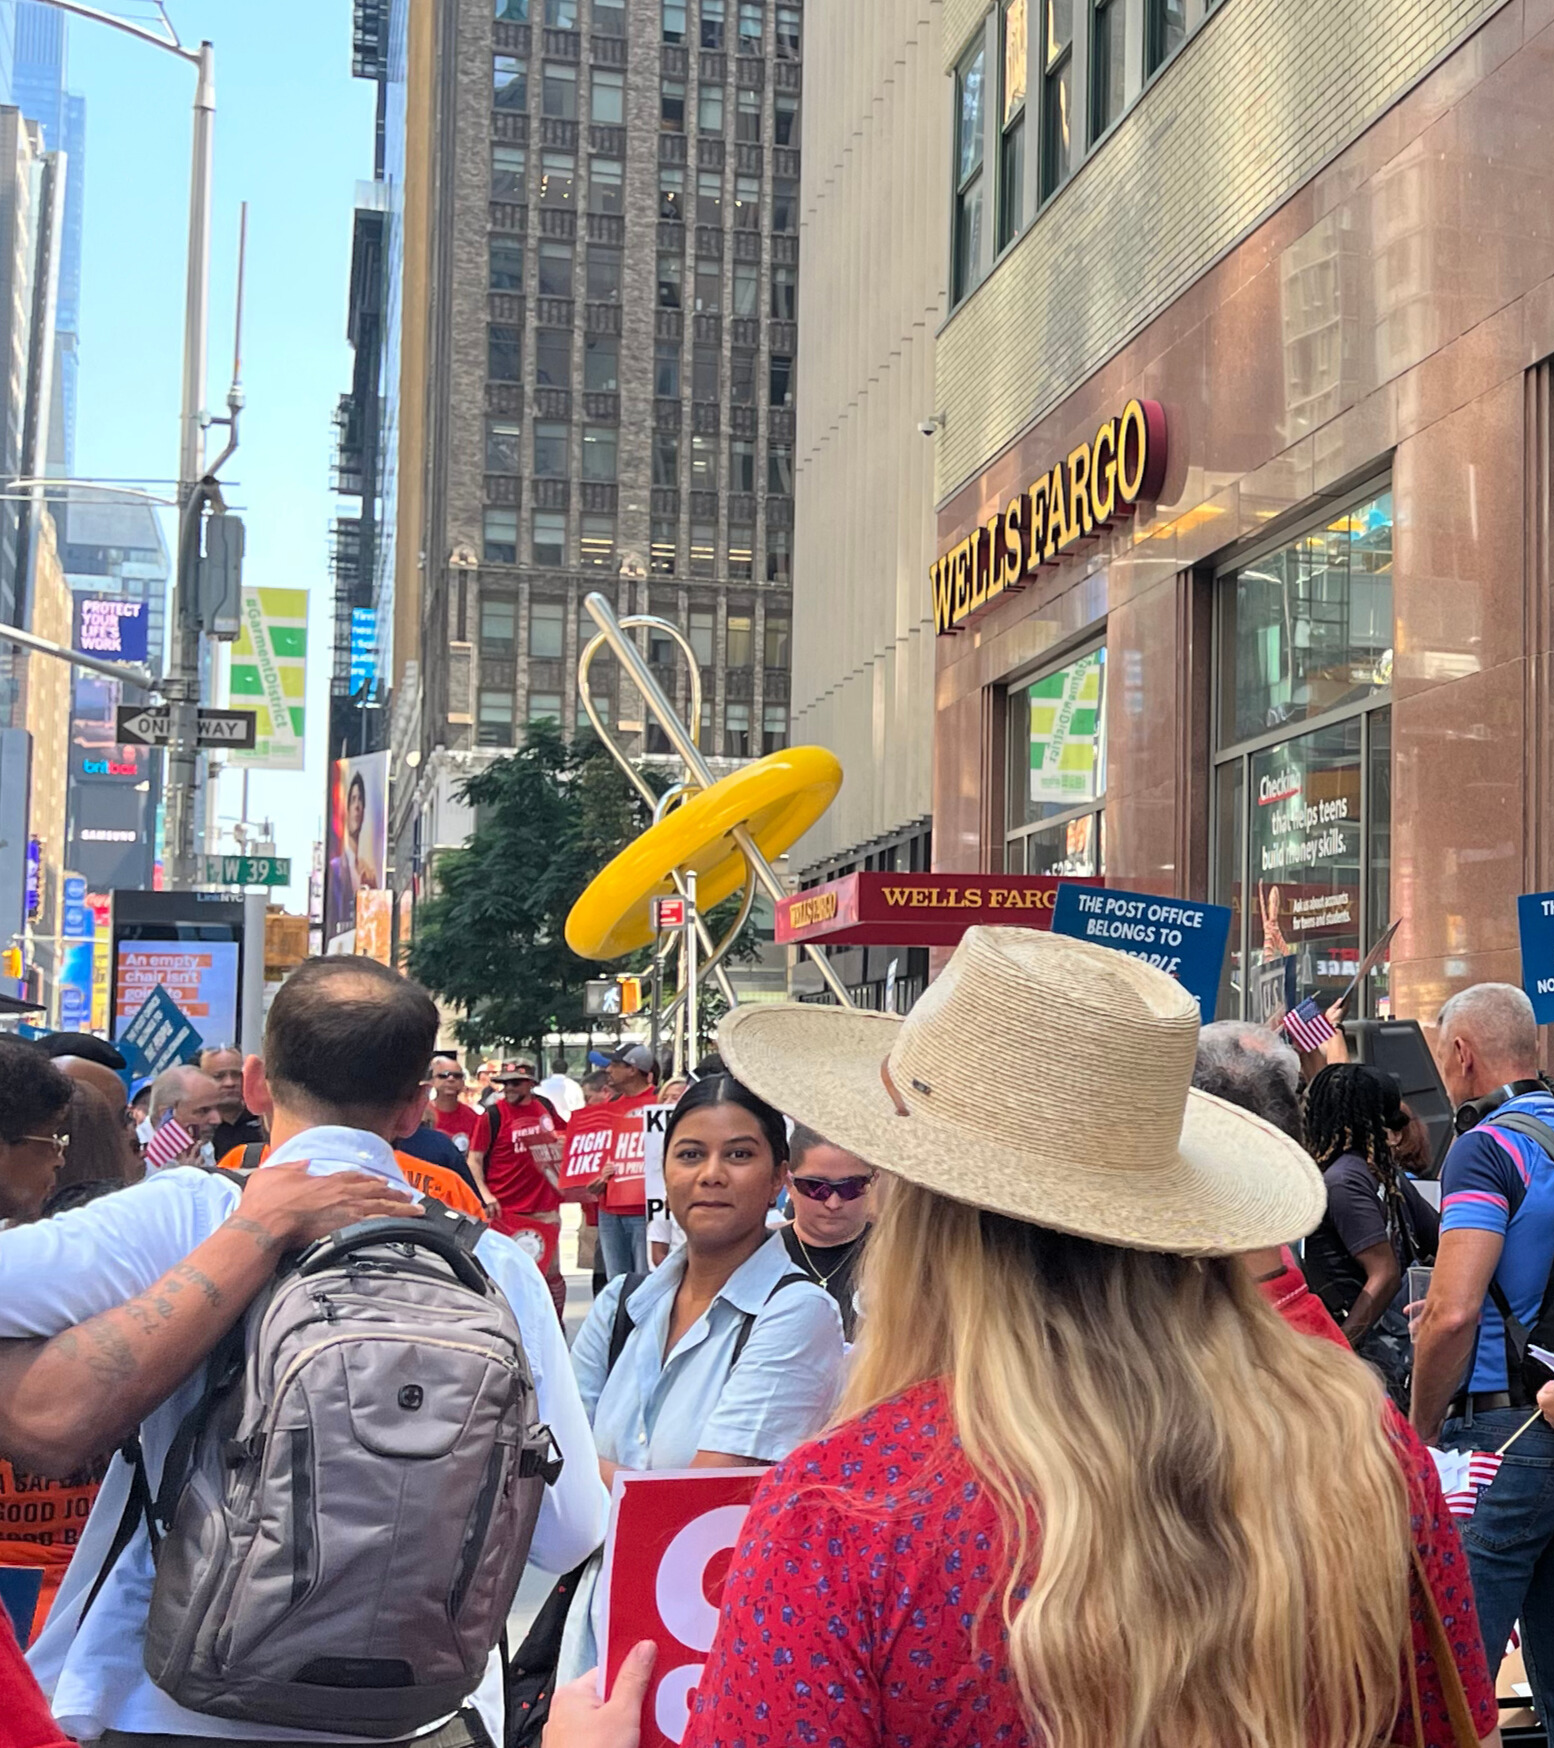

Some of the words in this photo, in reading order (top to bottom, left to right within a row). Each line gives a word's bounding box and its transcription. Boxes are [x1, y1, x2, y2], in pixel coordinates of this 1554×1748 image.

[929, 495, 1023, 636] WELLS
[1027, 398, 1148, 568] FARGO
[81, 613, 119, 627] YOUR
[82, 600, 141, 617] PROTECT
[81, 637, 121, 652] WORK
[198, 720, 238, 737] WAY
[1319, 797, 1348, 824] teens
[1261, 840, 1285, 871] build
[224, 859, 240, 882] W
[246, 859, 270, 882] 39
[881, 887, 982, 909] WELLS
[988, 888, 1057, 910] FARG
[1078, 894, 1103, 914] THE
[1105, 898, 1146, 919] POST
[1147, 905, 1204, 928] OFFICE
[1086, 918, 1155, 943] BELONGS
[1160, 928, 1182, 947] TO
[126, 954, 147, 966] An
[149, 955, 199, 970] empty
[125, 971, 164, 983] chair
[615, 1131, 646, 1160] HEL
[566, 1153, 603, 1177] LIKE
[64, 1497, 92, 1518] JO
